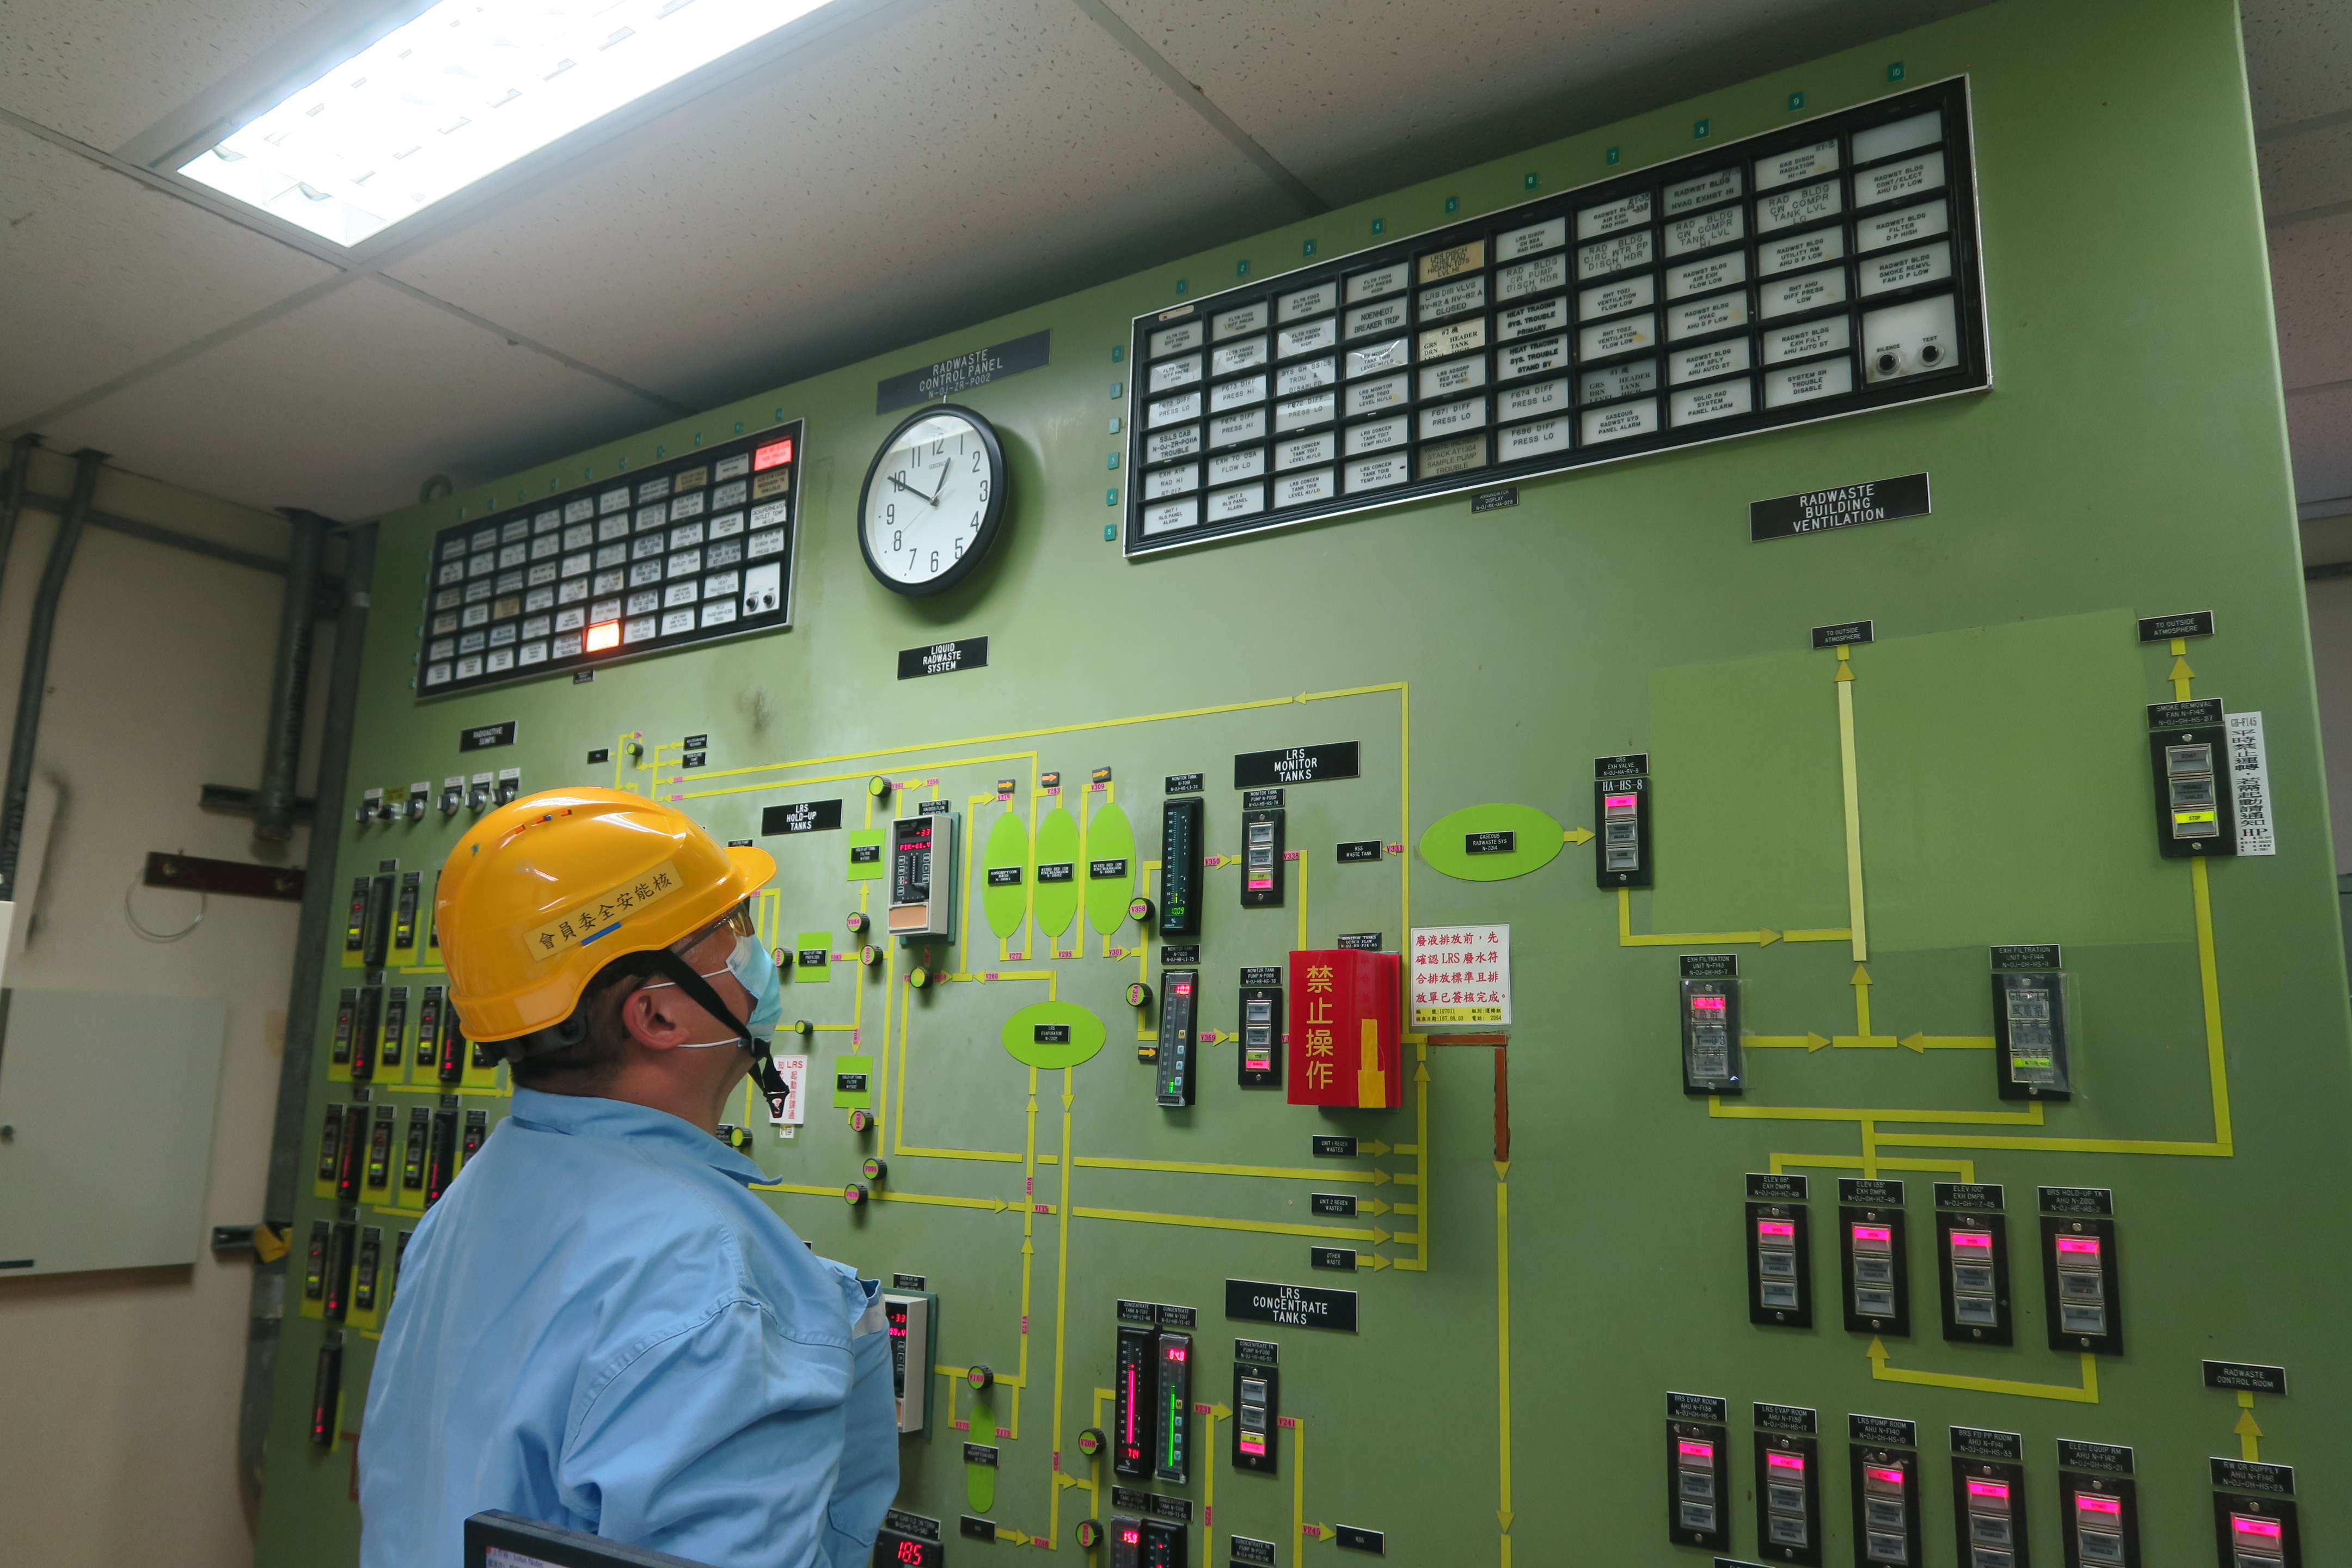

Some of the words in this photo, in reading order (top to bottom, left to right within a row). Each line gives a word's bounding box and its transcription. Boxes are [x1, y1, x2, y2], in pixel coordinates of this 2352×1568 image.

[1425, 292, 1440, 301] LRS
[1456, 281, 1475, 292] VLVS
[1420, 301, 1442, 311] RV-82
[1451, 292, 1475, 303] RV-82
[1436, 303, 1467, 315] CLOSED
[1354, 321, 1382, 333] BREAKER
[1385, 316, 1399, 326] TRIP
[1877, 344, 1900, 352] SILENCE
[933, 348, 988, 376] RADWASTE
[920, 367, 965, 392] CONTROL
[968, 357, 1002, 377] PANEL
[1788, 372, 1815, 382] SYSTEM
[1792, 377, 1823, 388] TROUBLE
[1793, 384, 1822, 395] DISABLE
[1453, 403, 1471, 412] DIFF
[1433, 416, 1456, 426] PRESS
[1606, 410, 1633, 420] GASEOUS
[1536, 422, 1555, 431] DIFF
[1600, 419, 1624, 427] RADWST
[933, 433, 944, 456] 12
[960, 434, 963, 455] 1
[1513, 436, 1539, 446] PRESS
[911, 446, 920, 468] 11
[1161, 446, 1189, 458] TROUBLE
[928, 461, 948, 470] SEIKO
[972, 450, 980, 473] 2
[1216, 457, 1228, 465] EXH
[894, 470, 905, 493] 10
[980, 480, 988, 501] 3
[1800, 485, 1874, 507] RADWASTE
[1806, 498, 1870, 518] BUILDING
[887, 504, 895, 525] 9
[1793, 507, 1884, 532] VENTILATION
[970, 511, 979, 532] 4
[894, 530, 901, 551] 8
[954, 537, 963, 560] 5
[909, 548, 917, 571] 7
[930, 551, 938, 572] 6
[2167, 618, 2195, 627] OUTSIDE
[1835, 627, 1858, 635] OUTSIDE
[2154, 625, 2198, 635] ATMOSPHERE
[1824, 634, 1861, 642] ATMOSPHERE
[931, 642, 954, 654] LIQUID
[923, 651, 961, 665] RADWASTE
[927, 660, 957, 673] SYSTEM
[2180, 701, 2213, 710] REMOVAL
[1286, 749, 1304, 759] LRS
[1275, 758, 1317, 771] MONITOR
[1279, 770, 1312, 782] TANKS
[1602, 779, 1642, 791] HA-HS-8
[795, 805, 808, 813] LRS
[786, 812, 817, 822] HOLD-UP
[790, 821, 811, 831] TANKS
[2242, 828, 2268, 836] HP
[1205, 857, 1220, 865] V350
[1131, 905, 1146, 913] V358
[1416, 954, 1438, 965] 確認
[1442, 953, 1460, 964] LRS
[1416, 971, 1498, 984] 合排放標準且排
[1306, 964, 1334, 1089] 禁止操作
[1280, 1288, 1300, 1298] LRS
[1253, 1296, 1327, 1315] CONCENTRATE
[1273, 1310, 1307, 1325] TANKS
[2224, 1368, 2264, 1379] RADWASTE
[2217, 1376, 2250, 1386] CONTROL
[2253, 1380, 2273, 1388] ROOM
[1195, 1405, 1210, 1413] V231
[1279, 1418, 1295, 1426] V241
[1080, 1439, 1096, 1447] V208
[1303, 1526, 1321, 1535] V245
